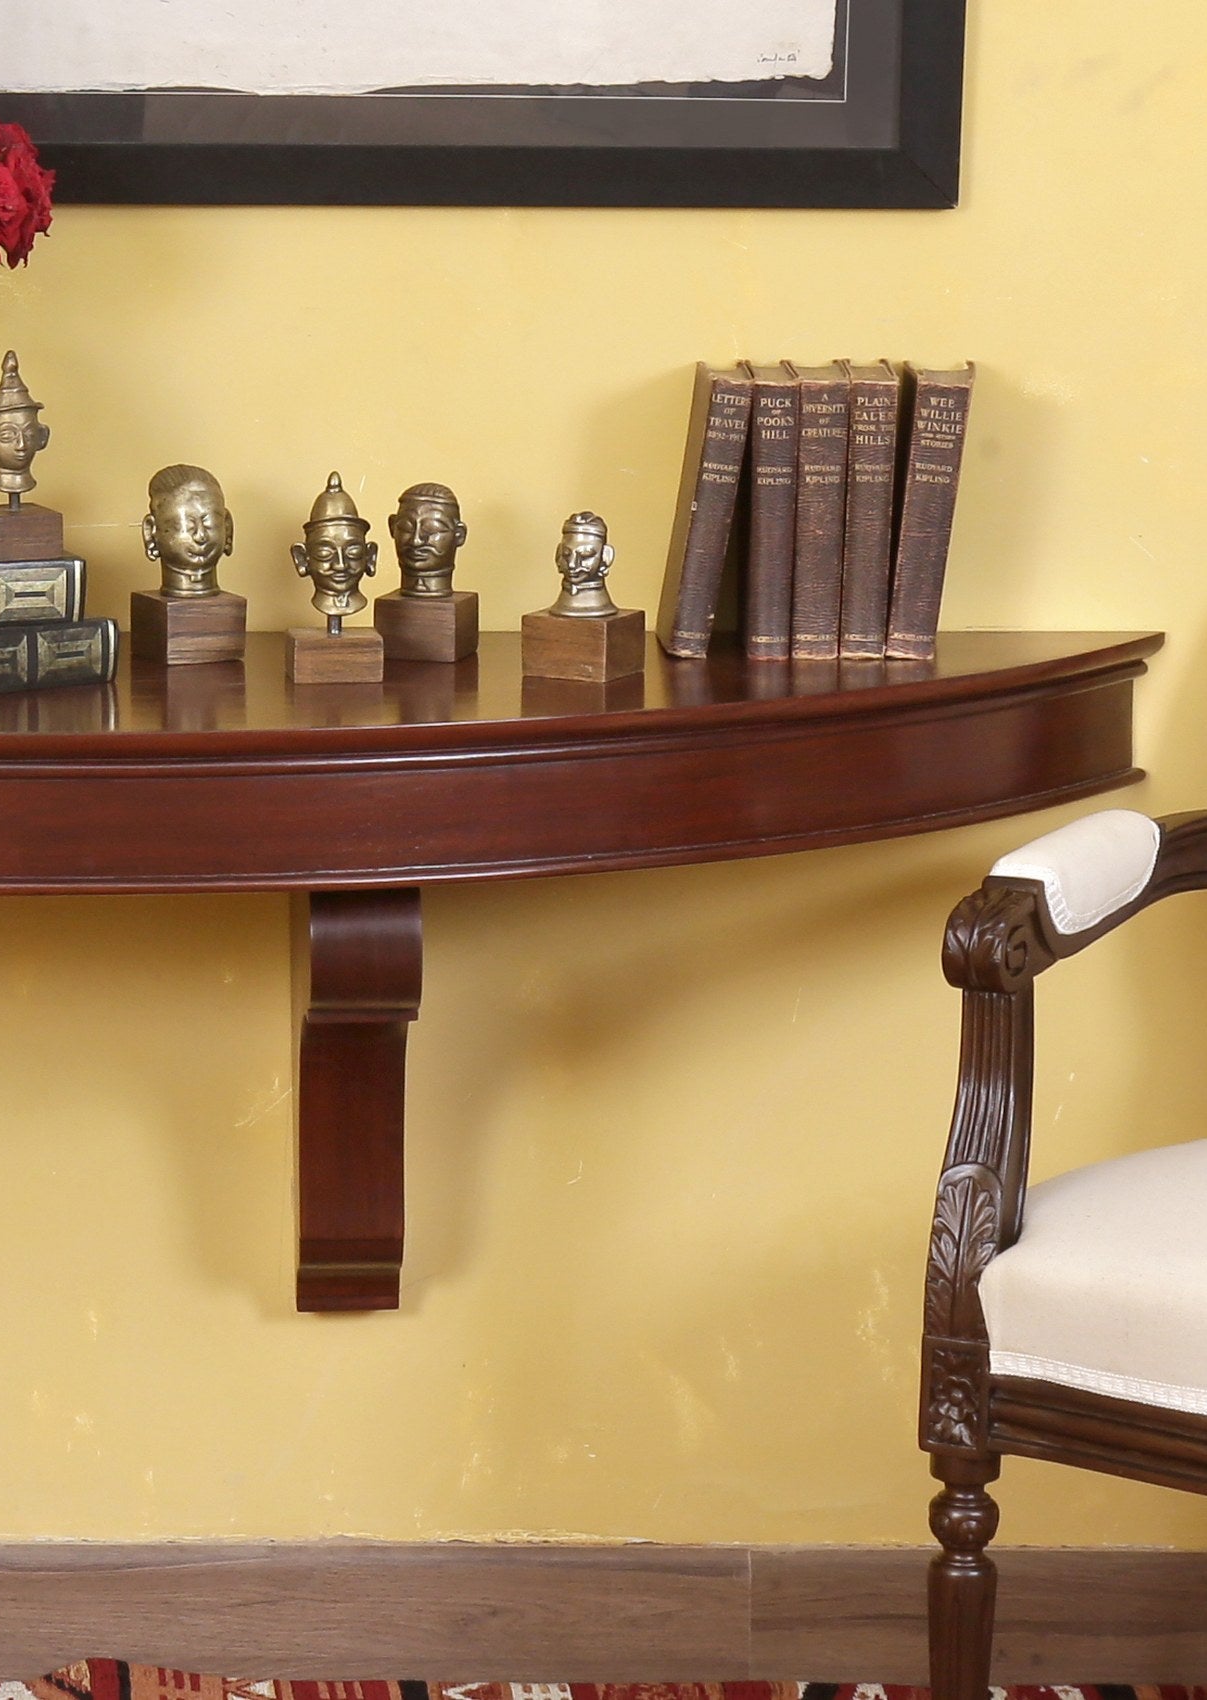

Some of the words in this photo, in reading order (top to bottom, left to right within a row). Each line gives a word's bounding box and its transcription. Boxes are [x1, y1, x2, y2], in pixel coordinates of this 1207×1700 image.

[760, 397, 792, 408] PUCK
[821, 393, 829, 402] A
[857, 397, 891, 407] PLAIN
[929, 397, 955, 408] WEE
[802, 403, 846, 414] DIVERSITY
[920, 408, 962, 421] WILLIE
[709, 416, 746, 430] TRAVEL
[917, 420, 962, 434] WINKIE
[761, 429, 790, 440] HILL
[855, 435, 890, 445] HILLS
[757, 466, 793, 474] RUDYARD
[915, 462, 953, 473] RUDYARD
[702, 472, 736, 484] KIPLING
[757, 477, 791, 486] KIPLING
[805, 476, 841, 484] KIPLING
[855, 475, 890, 483] KIPLING
[915, 474, 950, 484] KIPLING
